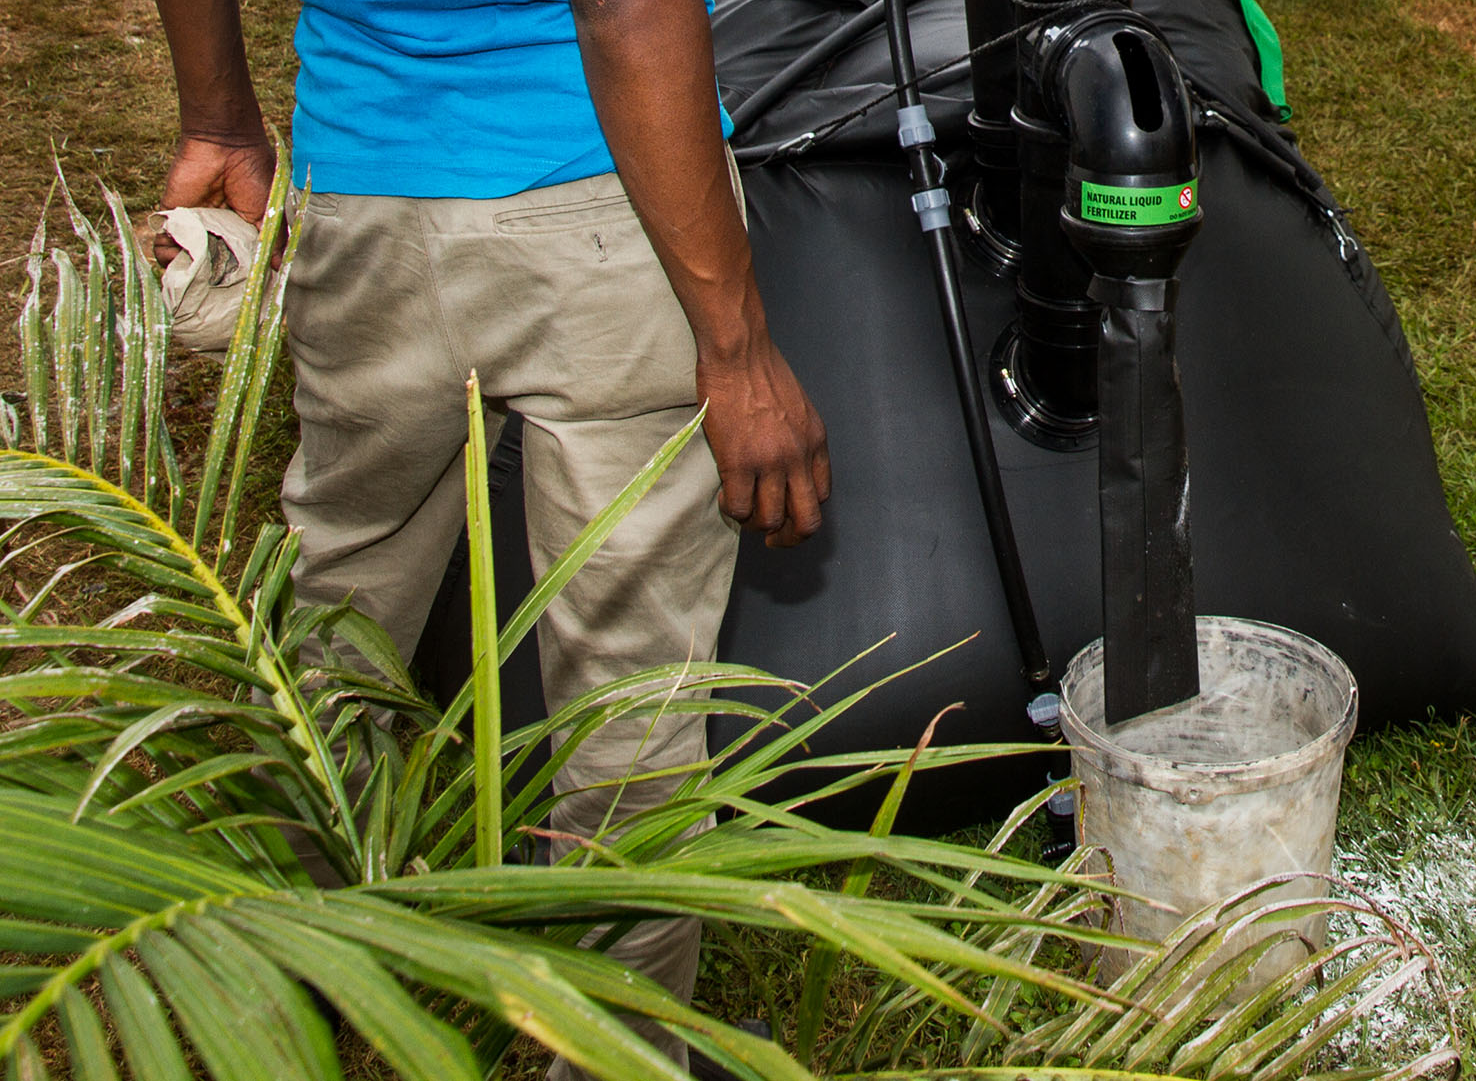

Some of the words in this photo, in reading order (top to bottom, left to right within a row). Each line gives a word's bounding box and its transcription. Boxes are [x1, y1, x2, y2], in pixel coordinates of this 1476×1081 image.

[1086, 191, 1127, 206] NATURAL
[1129, 195, 1163, 207] LIQUID
[1086, 205, 1137, 220] FERTILIZER
